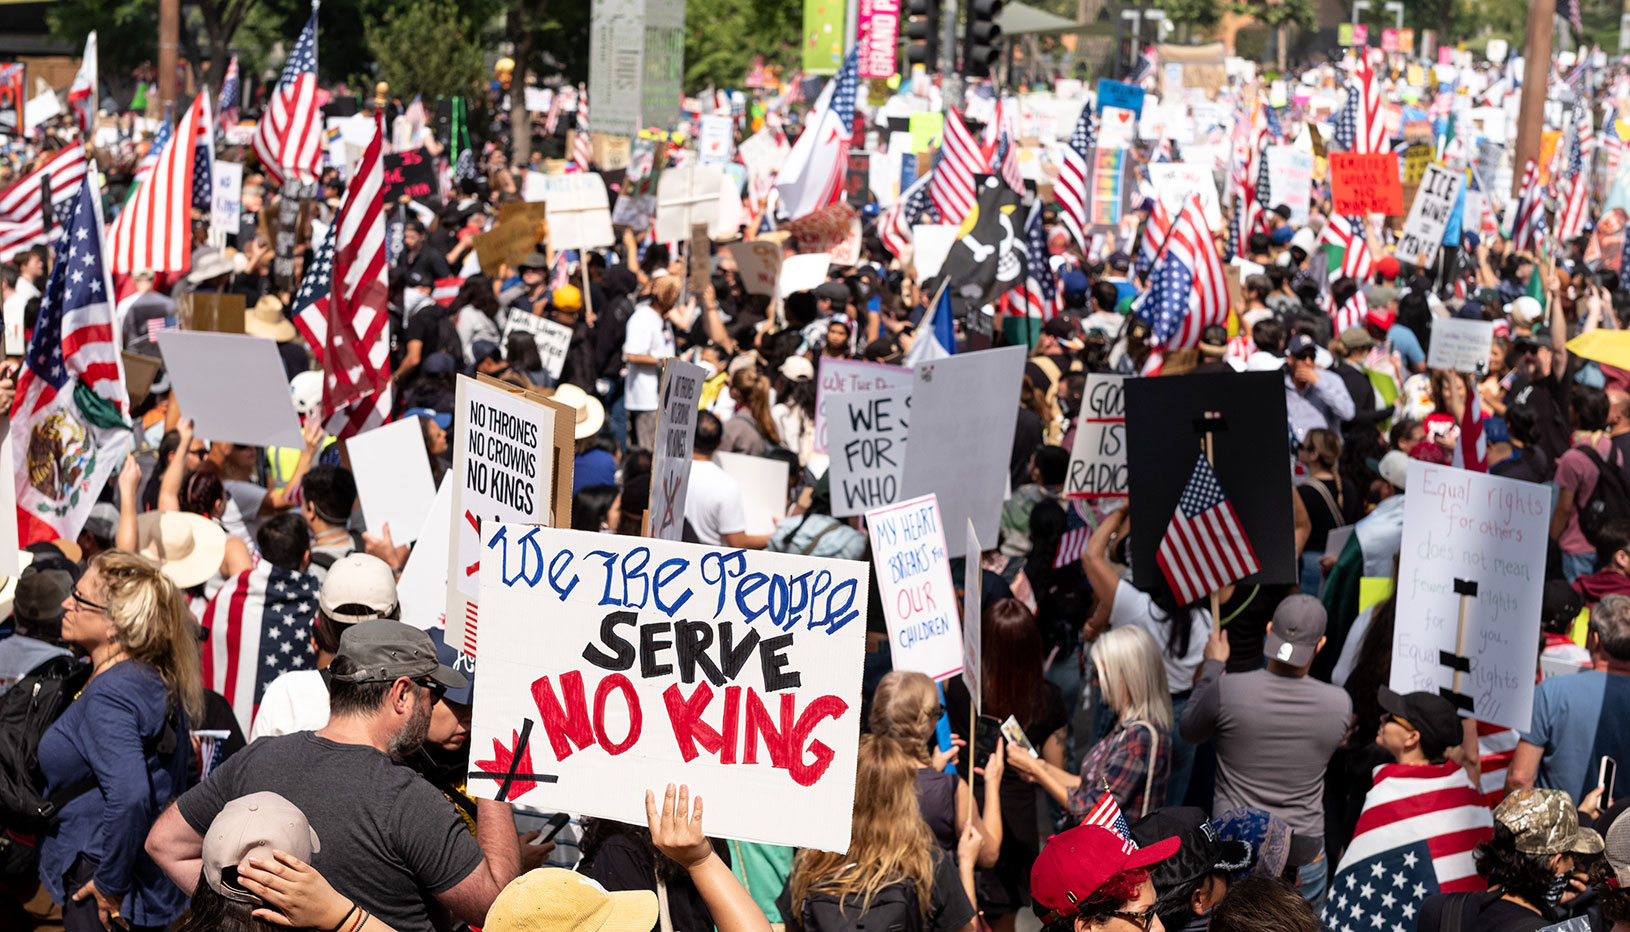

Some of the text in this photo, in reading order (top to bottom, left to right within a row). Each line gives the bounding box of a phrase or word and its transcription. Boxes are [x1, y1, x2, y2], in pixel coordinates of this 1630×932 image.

[470, 400, 538, 449] NO THRONES
[848, 398, 893, 433] WE
[468, 429, 536, 479] NO CROWNS
[845, 437, 897, 472] FOR
[1099, 424, 1125, 456] IS
[467, 457, 535, 516] NO KINGS
[843, 475, 897, 509] WHO
[1423, 468, 1544, 526] Equal rights
[876, 505, 937, 551] MY HEART
[1446, 503, 1523, 543] for others
[488, 525, 580, 602] We
[888, 543, 930, 584] BREAKS
[1418, 530, 1530, 581] does not mean
[897, 580, 936, 620] OUR
[1425, 608, 1446, 631] for
[1480, 590, 1518, 622] rights
[898, 611, 950, 649] CHILDREN
[582, 610, 801, 692] SERVE
[530, 669, 849, 787] NO KING
